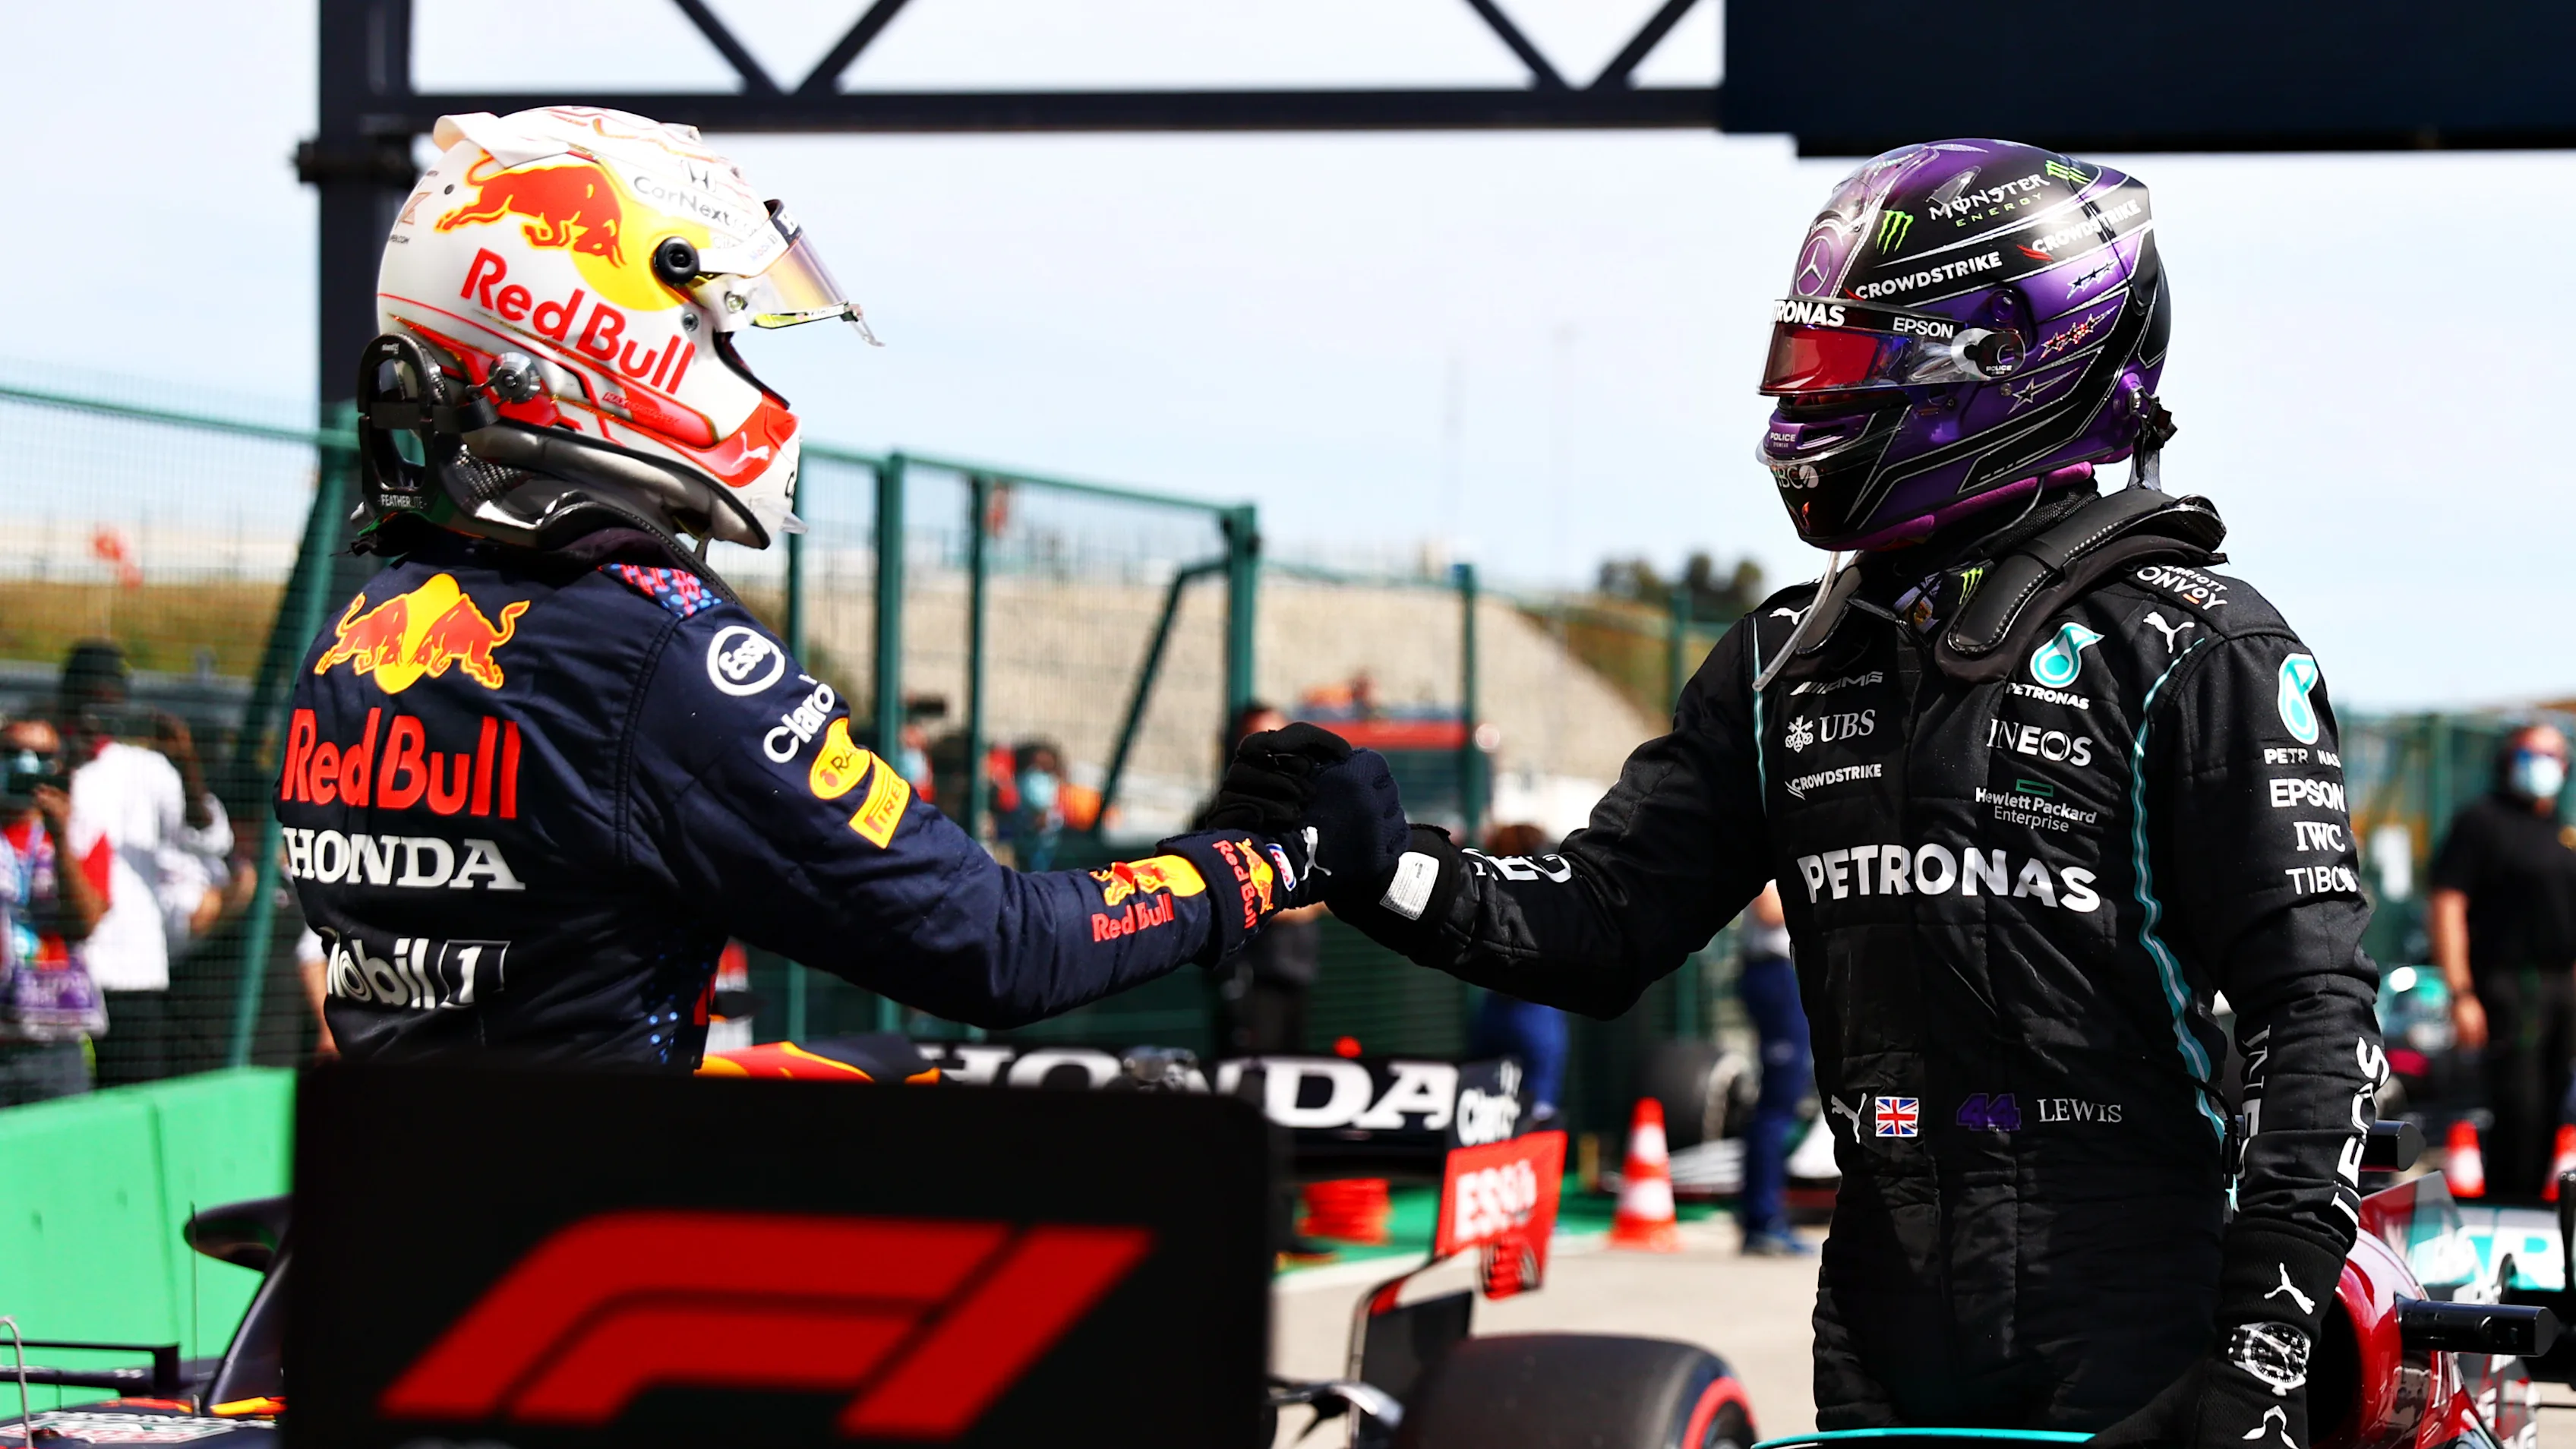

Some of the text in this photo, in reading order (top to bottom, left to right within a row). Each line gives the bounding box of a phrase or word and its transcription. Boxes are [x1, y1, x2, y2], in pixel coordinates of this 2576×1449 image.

[1929, 173, 2050, 222] MONSTER
[1955, 192, 2043, 228] ENERGY
[2031, 199, 2142, 255] CROWDSTRIKE
[1855, 251, 2003, 300] CROWDSTRIKE
[460, 248, 696, 396] Red Bull
[1893, 317, 1954, 339] EPSON
[1770, 432, 1796, 442] POLICE
[2136, 566, 2228, 611] ONVOY
[2161, 565, 2228, 592] ARRIOTT
[2005, 682, 2091, 711] PETRONAS
[762, 682, 835, 764] Claro
[1819, 709, 1877, 743] UBS
[1985, 718, 2094, 767] INEOS
[281, 707, 522, 819] Red Bull
[1791, 763, 1883, 791] CROWDSTRIKE
[2263, 747, 2342, 769] PETRNAS
[1975, 787, 2098, 824] Hewlett Packard
[2268, 778, 2347, 813] EPSON
[1994, 806, 2070, 832] Enterprise
[2293, 821, 2347, 853] IWC
[282, 826, 526, 891] HONDA
[1796, 841, 2102, 913] PETRONAS
[1213, 839, 1258, 930] Red Bull
[1091, 892, 1174, 942] Red Bull
[917, 1045, 1457, 1130] HODA
[1956, 1092, 2123, 1132] 44 LEWIS
[2330, 1036, 2391, 1232] IEOS
